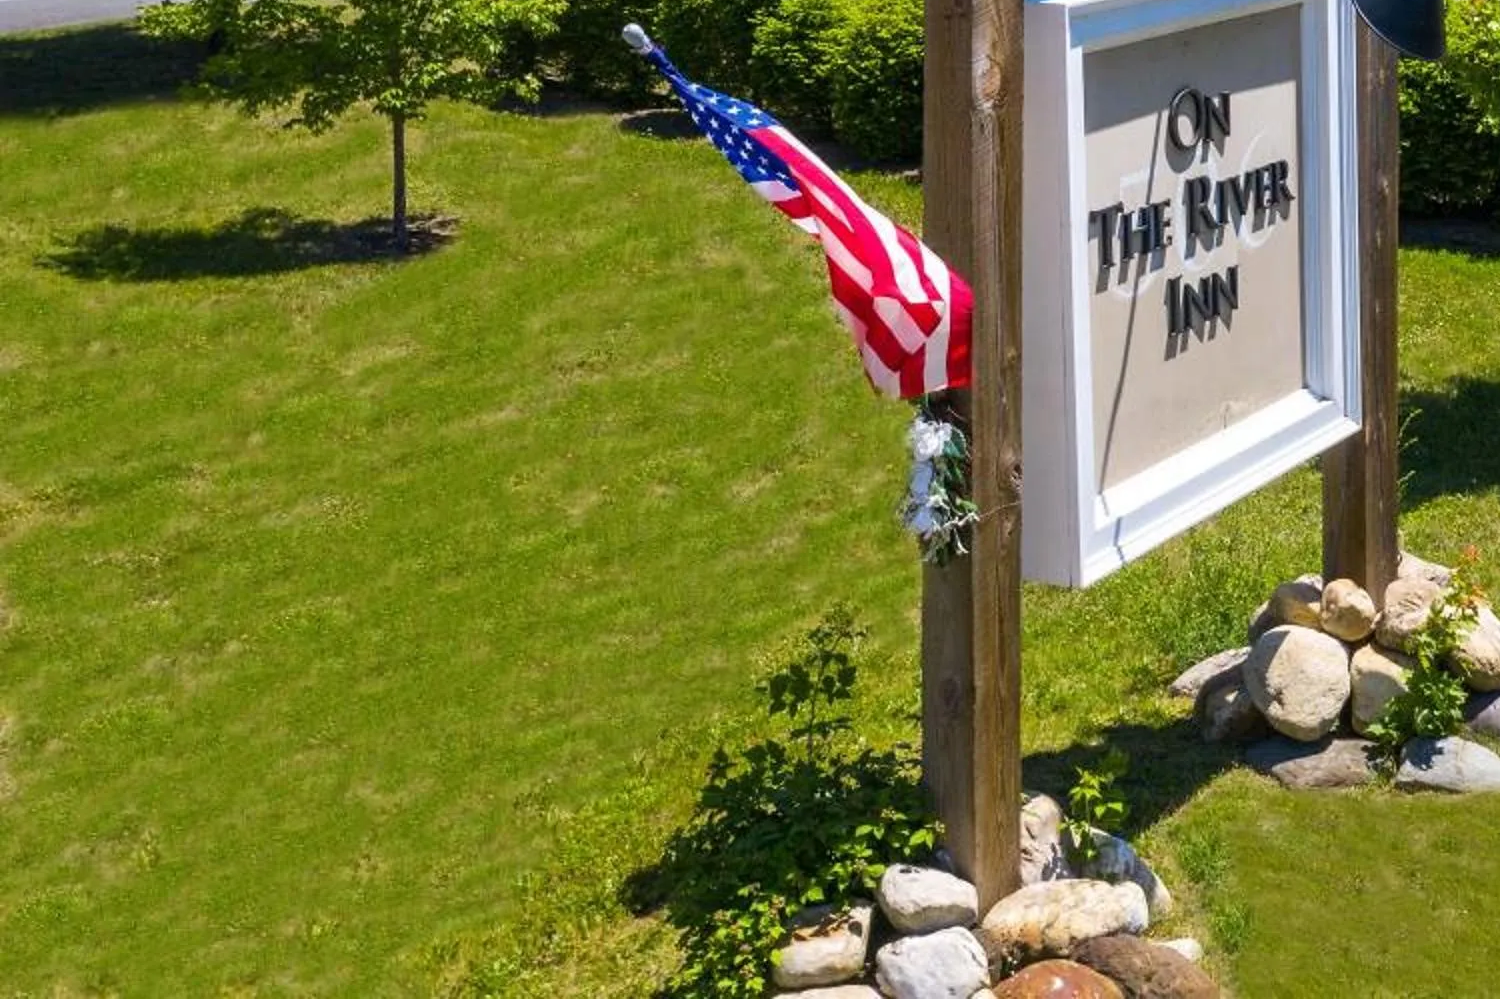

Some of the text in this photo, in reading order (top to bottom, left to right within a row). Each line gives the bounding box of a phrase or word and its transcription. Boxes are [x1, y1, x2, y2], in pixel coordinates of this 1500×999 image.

[1169, 87, 1231, 151] ON
[1090, 159, 1296, 269] THE RIVER
[1165, 265, 1239, 335] INN
